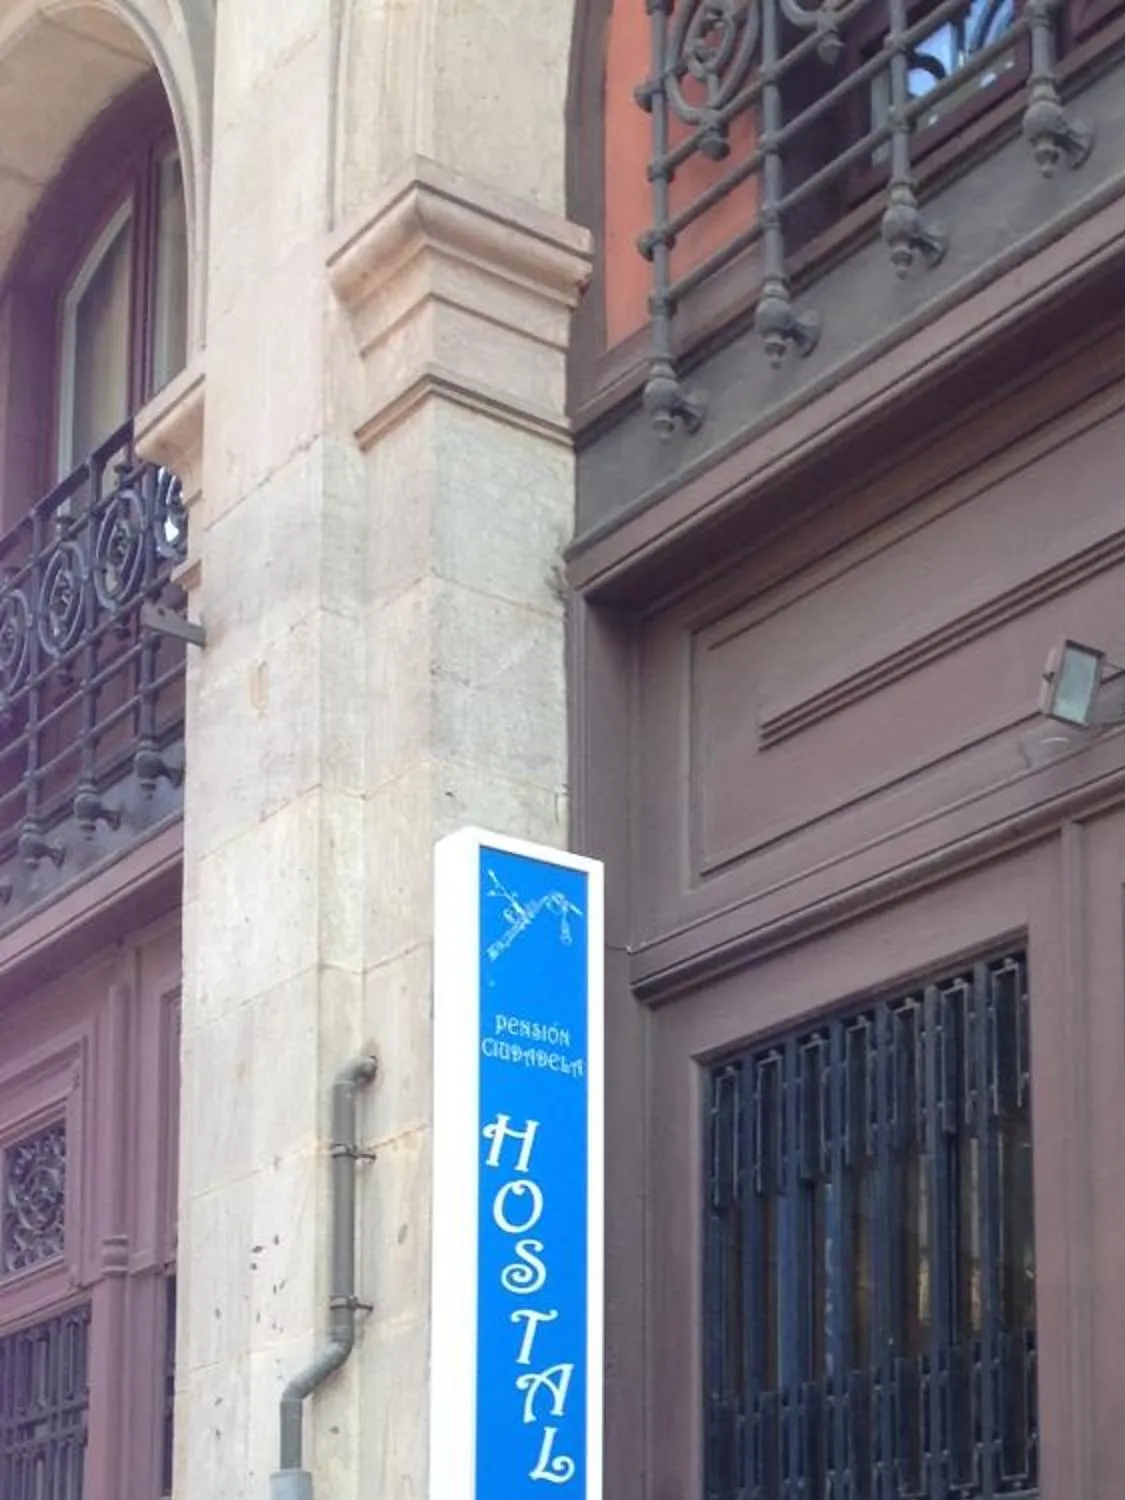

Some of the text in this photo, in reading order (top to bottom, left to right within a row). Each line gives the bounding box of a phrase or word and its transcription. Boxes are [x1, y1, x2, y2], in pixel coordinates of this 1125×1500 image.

[495, 1014, 570, 1047] PENSIÓN
[481, 1037, 584, 1077] CIUDADELA
[482, 1112, 576, 1484] HOSTAL
